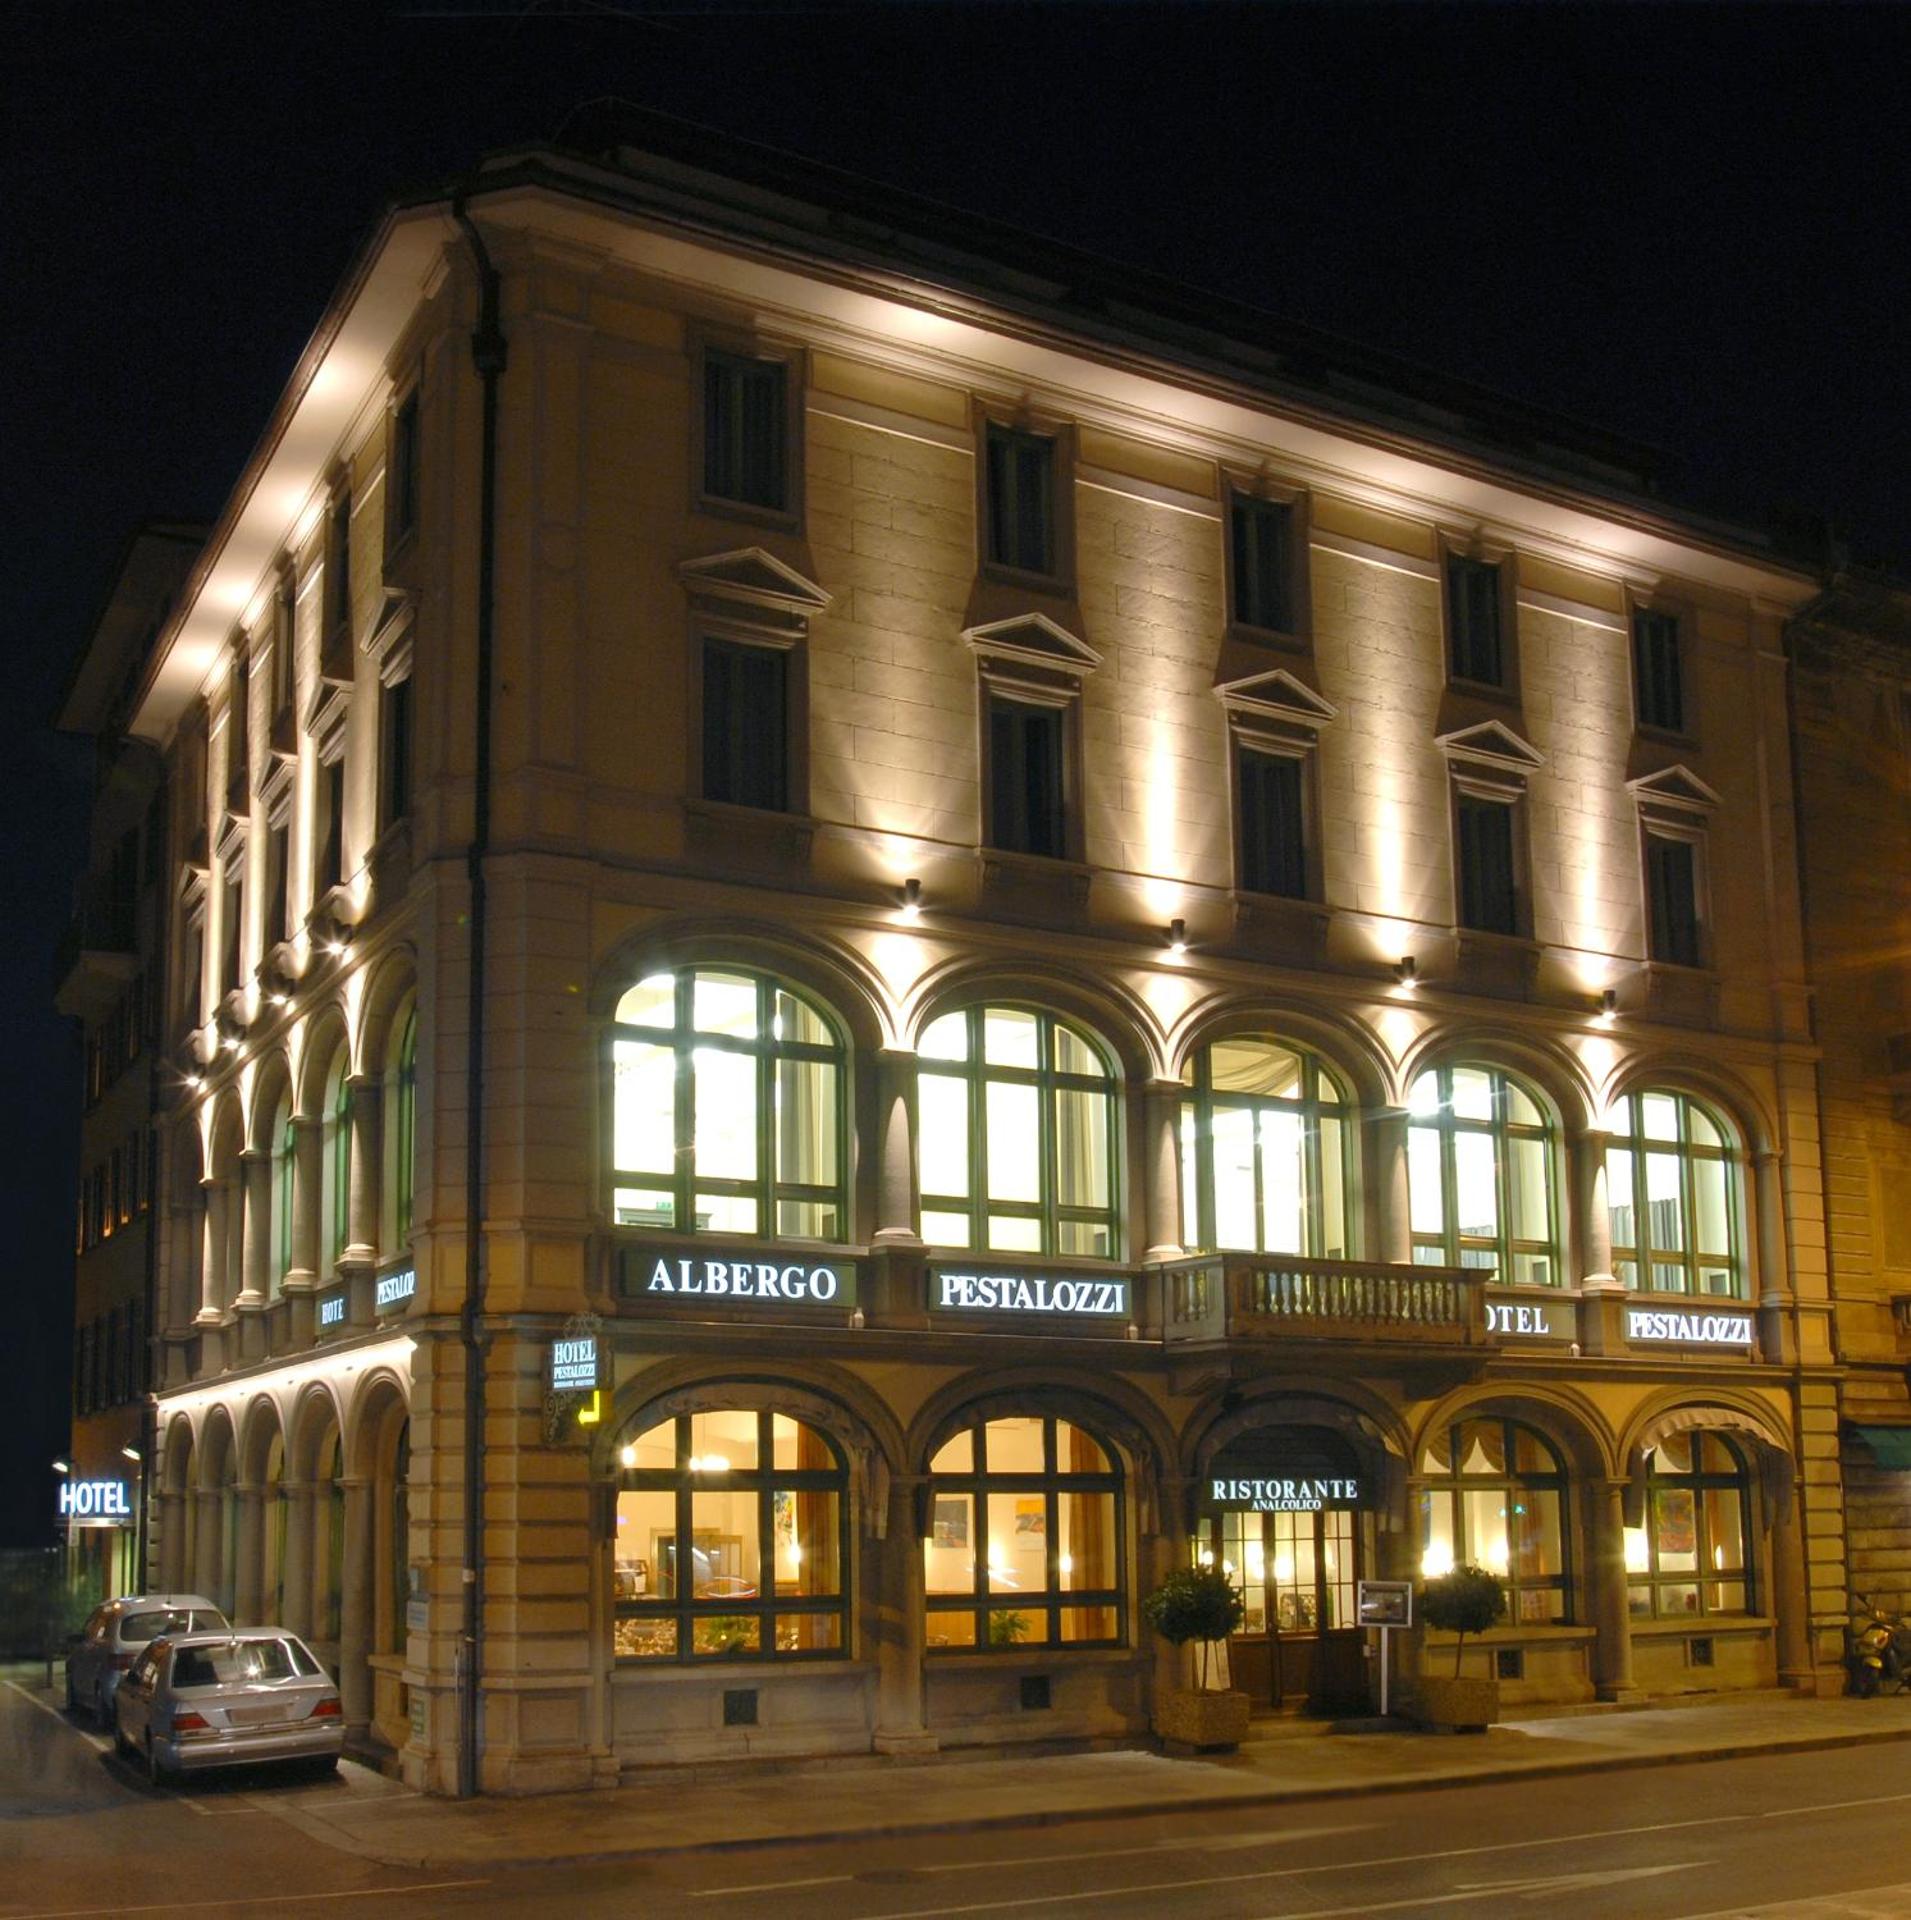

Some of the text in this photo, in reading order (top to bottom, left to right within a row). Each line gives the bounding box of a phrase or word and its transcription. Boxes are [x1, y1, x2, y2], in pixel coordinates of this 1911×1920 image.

[648, 1259, 837, 1300] ALBERGO
[940, 1275, 1124, 1313] PESTALOZZI
[1628, 1311, 1752, 1344] PESTALOZZI
[554, 1340, 596, 1364] HOTEL
[60, 1482, 130, 1514] HOTEL
[1212, 1480, 1359, 1500] RISTORANTE
[1251, 1499, 1322, 1511] ANALCOLICO
